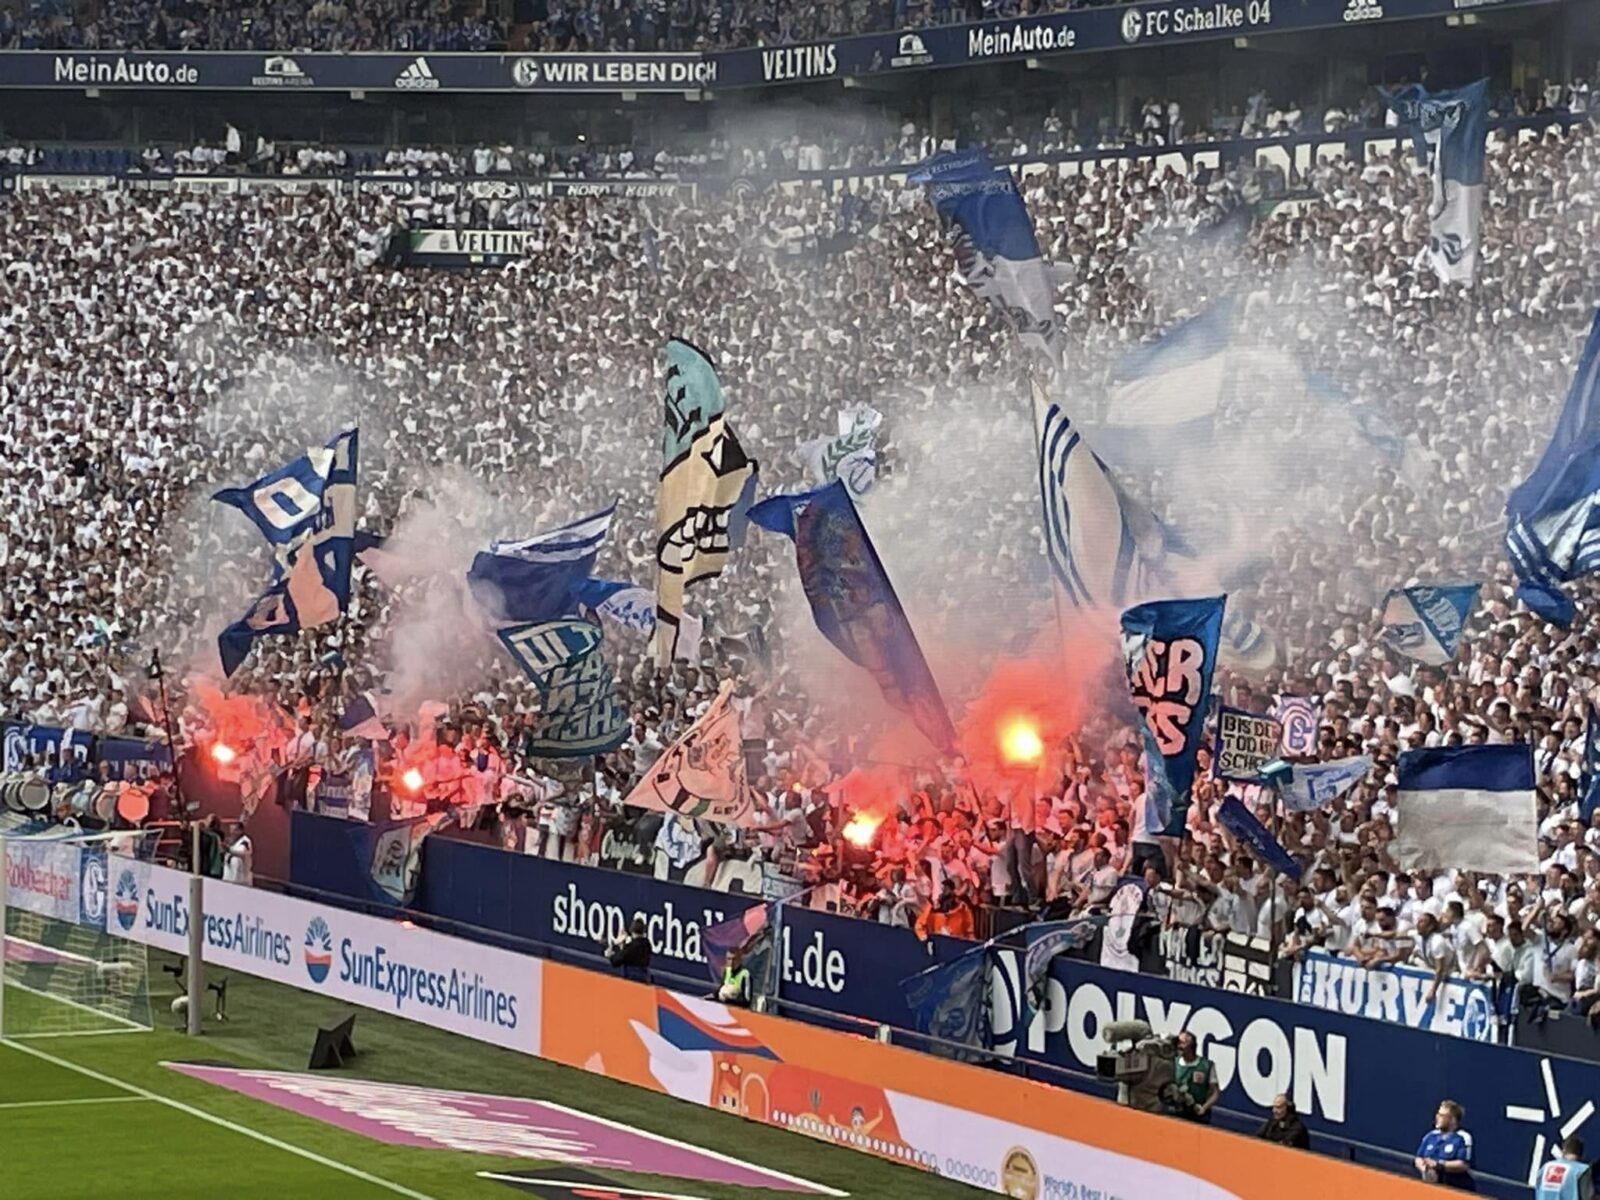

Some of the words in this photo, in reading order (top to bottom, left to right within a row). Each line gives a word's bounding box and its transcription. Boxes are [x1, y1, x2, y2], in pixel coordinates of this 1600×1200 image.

[1145, 13, 1169, 36] FC
[1173, 4, 1243, 33] Schalke
[1248, 0, 1271, 24] 04
[968, 24, 1076, 58] MeinAuto.de
[55, 56, 198, 84] MeinAuto.de
[544, 62, 588, 82] WIR
[592, 62, 666, 82] LEBEN
[671, 61, 717, 83] DICH
[762, 44, 838, 81] VELTINS
[395, 77, 440, 89] adidas
[1224, 715, 1251, 735] BIS
[1223, 733, 1256, 753] TOD
[146, 888, 291, 966] SunExressAirlines
[340, 938, 518, 1030] SunExpressAirlines
[1313, 959, 1467, 1038] KURVE
